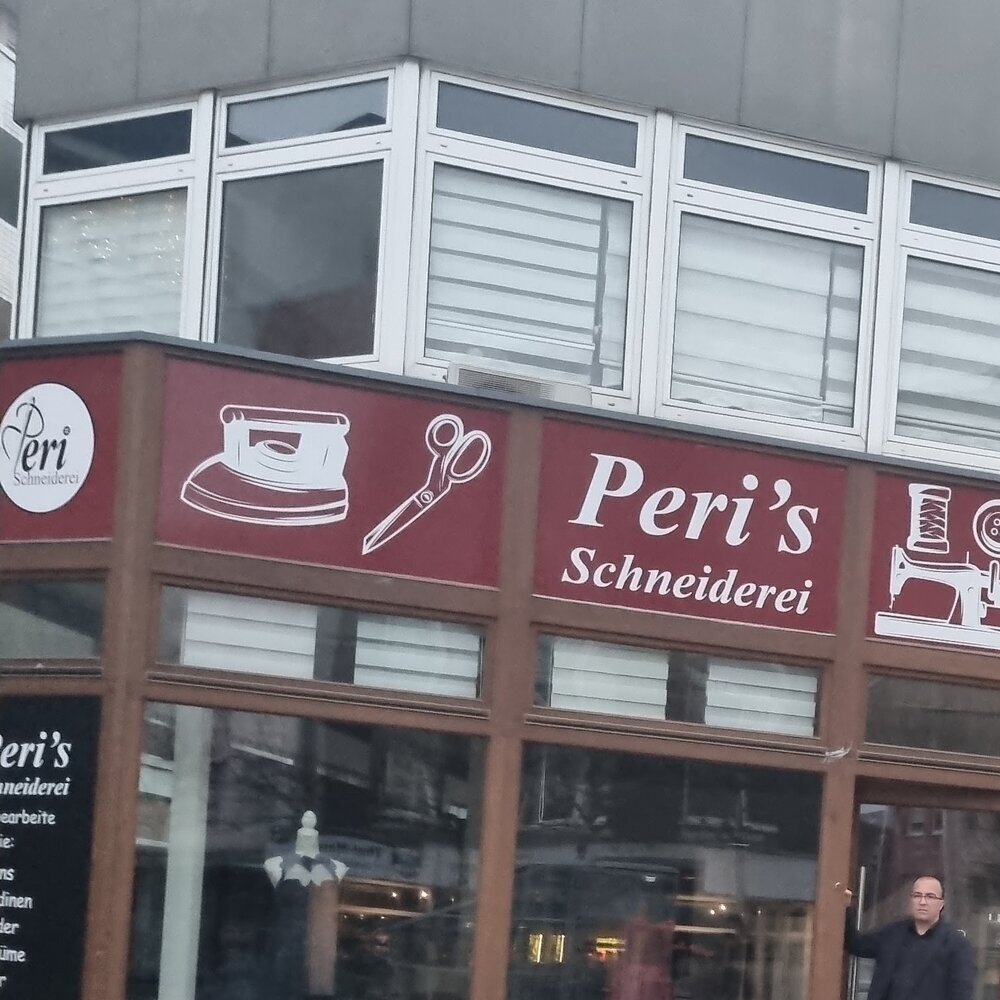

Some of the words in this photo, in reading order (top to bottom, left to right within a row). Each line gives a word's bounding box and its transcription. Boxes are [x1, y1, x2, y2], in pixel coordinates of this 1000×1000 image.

[13, 472, 79, 486] Schneiderei
[561, 547, 813, 614] Schneiderei
[0, 731, 72, 768] eri's
[0, 809, 56, 824] earbeite
